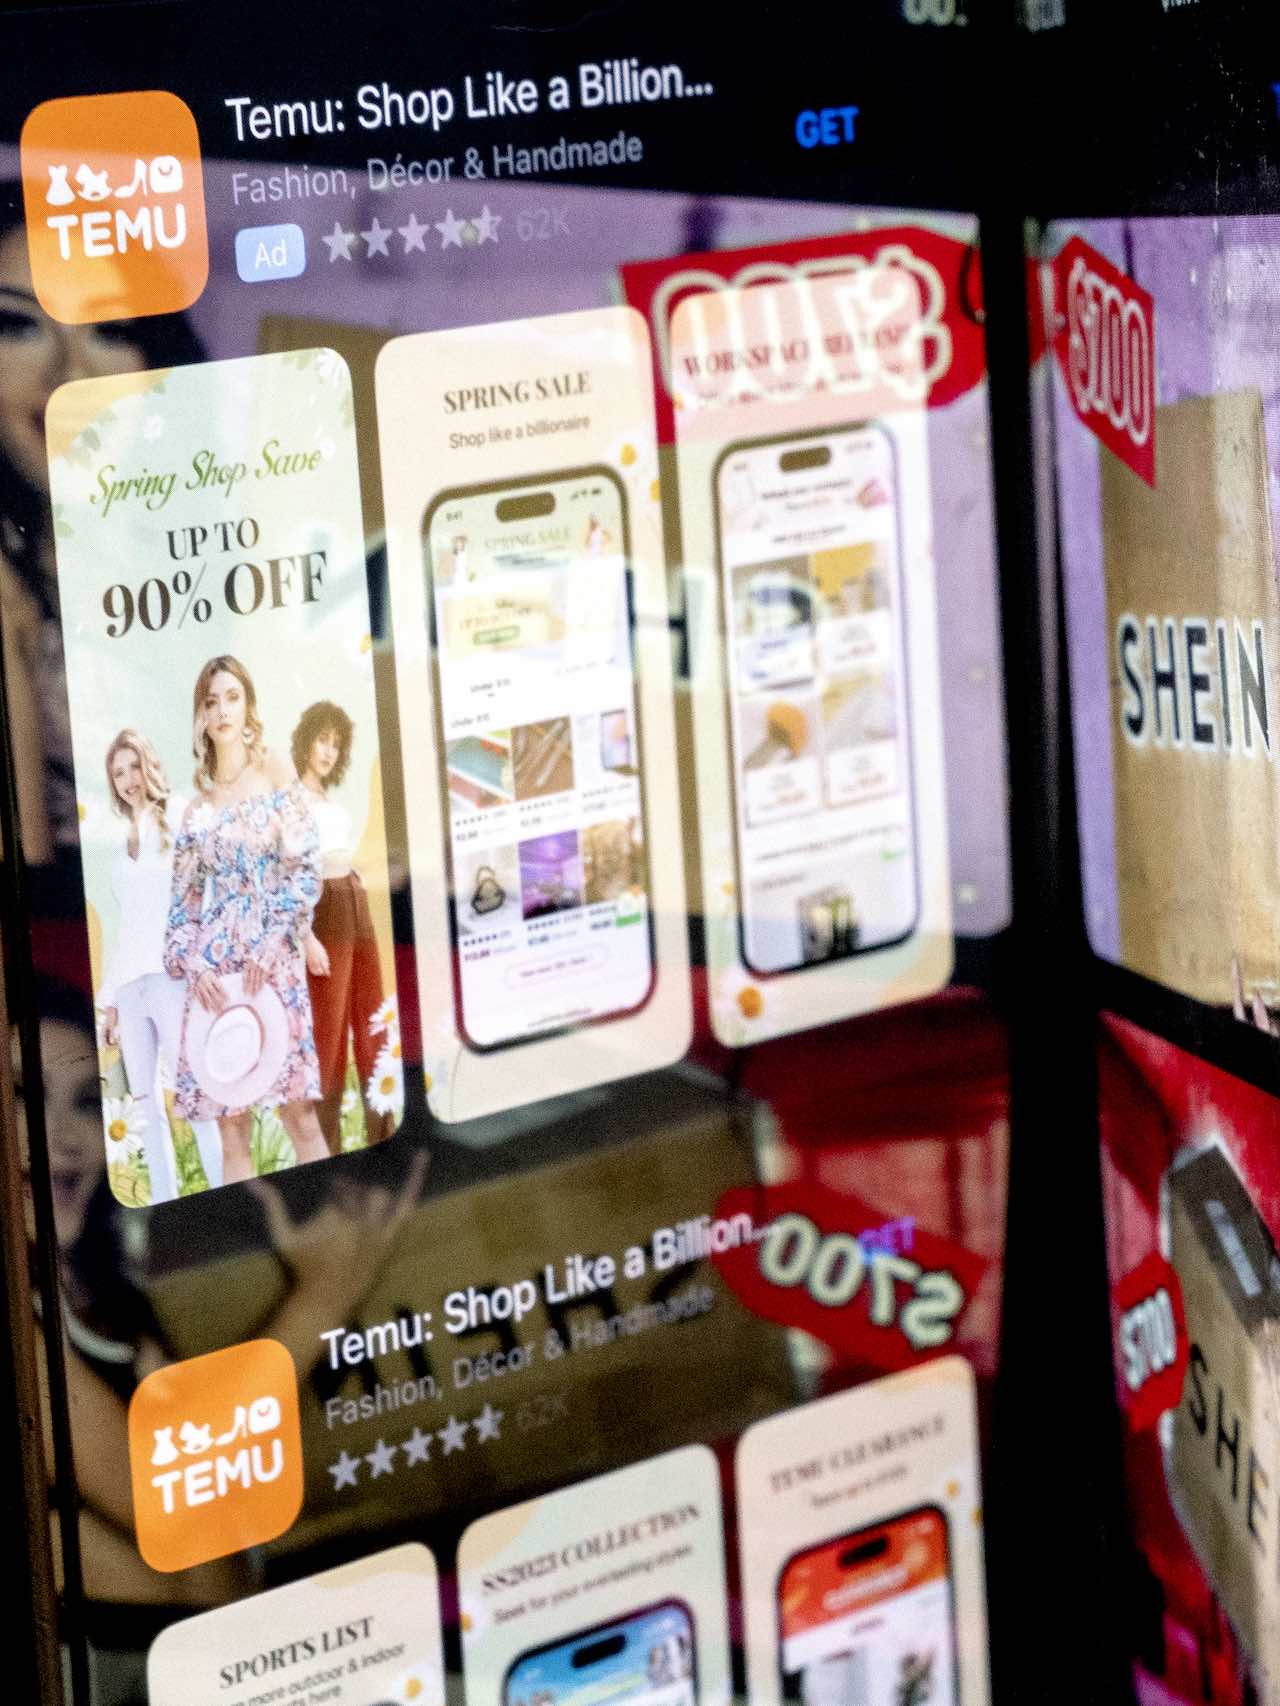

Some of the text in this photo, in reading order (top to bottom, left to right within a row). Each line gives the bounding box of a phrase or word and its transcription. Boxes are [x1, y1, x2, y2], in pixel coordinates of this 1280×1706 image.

[224, 97, 345, 141] Temu:
[357, 82, 454, 131] Shop
[465, 71, 538, 118] Like
[548, 75, 570, 110] a
[795, 105, 860, 148] GET
[232, 130, 643, 205] Fashion, Décor & Handmade
[46, 204, 187, 260] TEMU
[254, 239, 288, 269] Ad
[443, 370, 591, 415] SPRING SALE
[449, 431, 486, 449] Shop
[90, 440, 322, 518] Spring Shop Save
[167, 517, 260, 560] UP TO
[102, 551, 326, 638] 90% OFF
[1118, 615, 1271, 757] SHEIN
[319, 1310, 434, 1371] Temu:
[443, 1279, 537, 1334] Shop
[543, 1253, 616, 1304] Like
[622, 1246, 646, 1279] a
[150, 1437, 285, 1515] TEMU
[219, 1615, 375, 1689] SPORTS LIST
